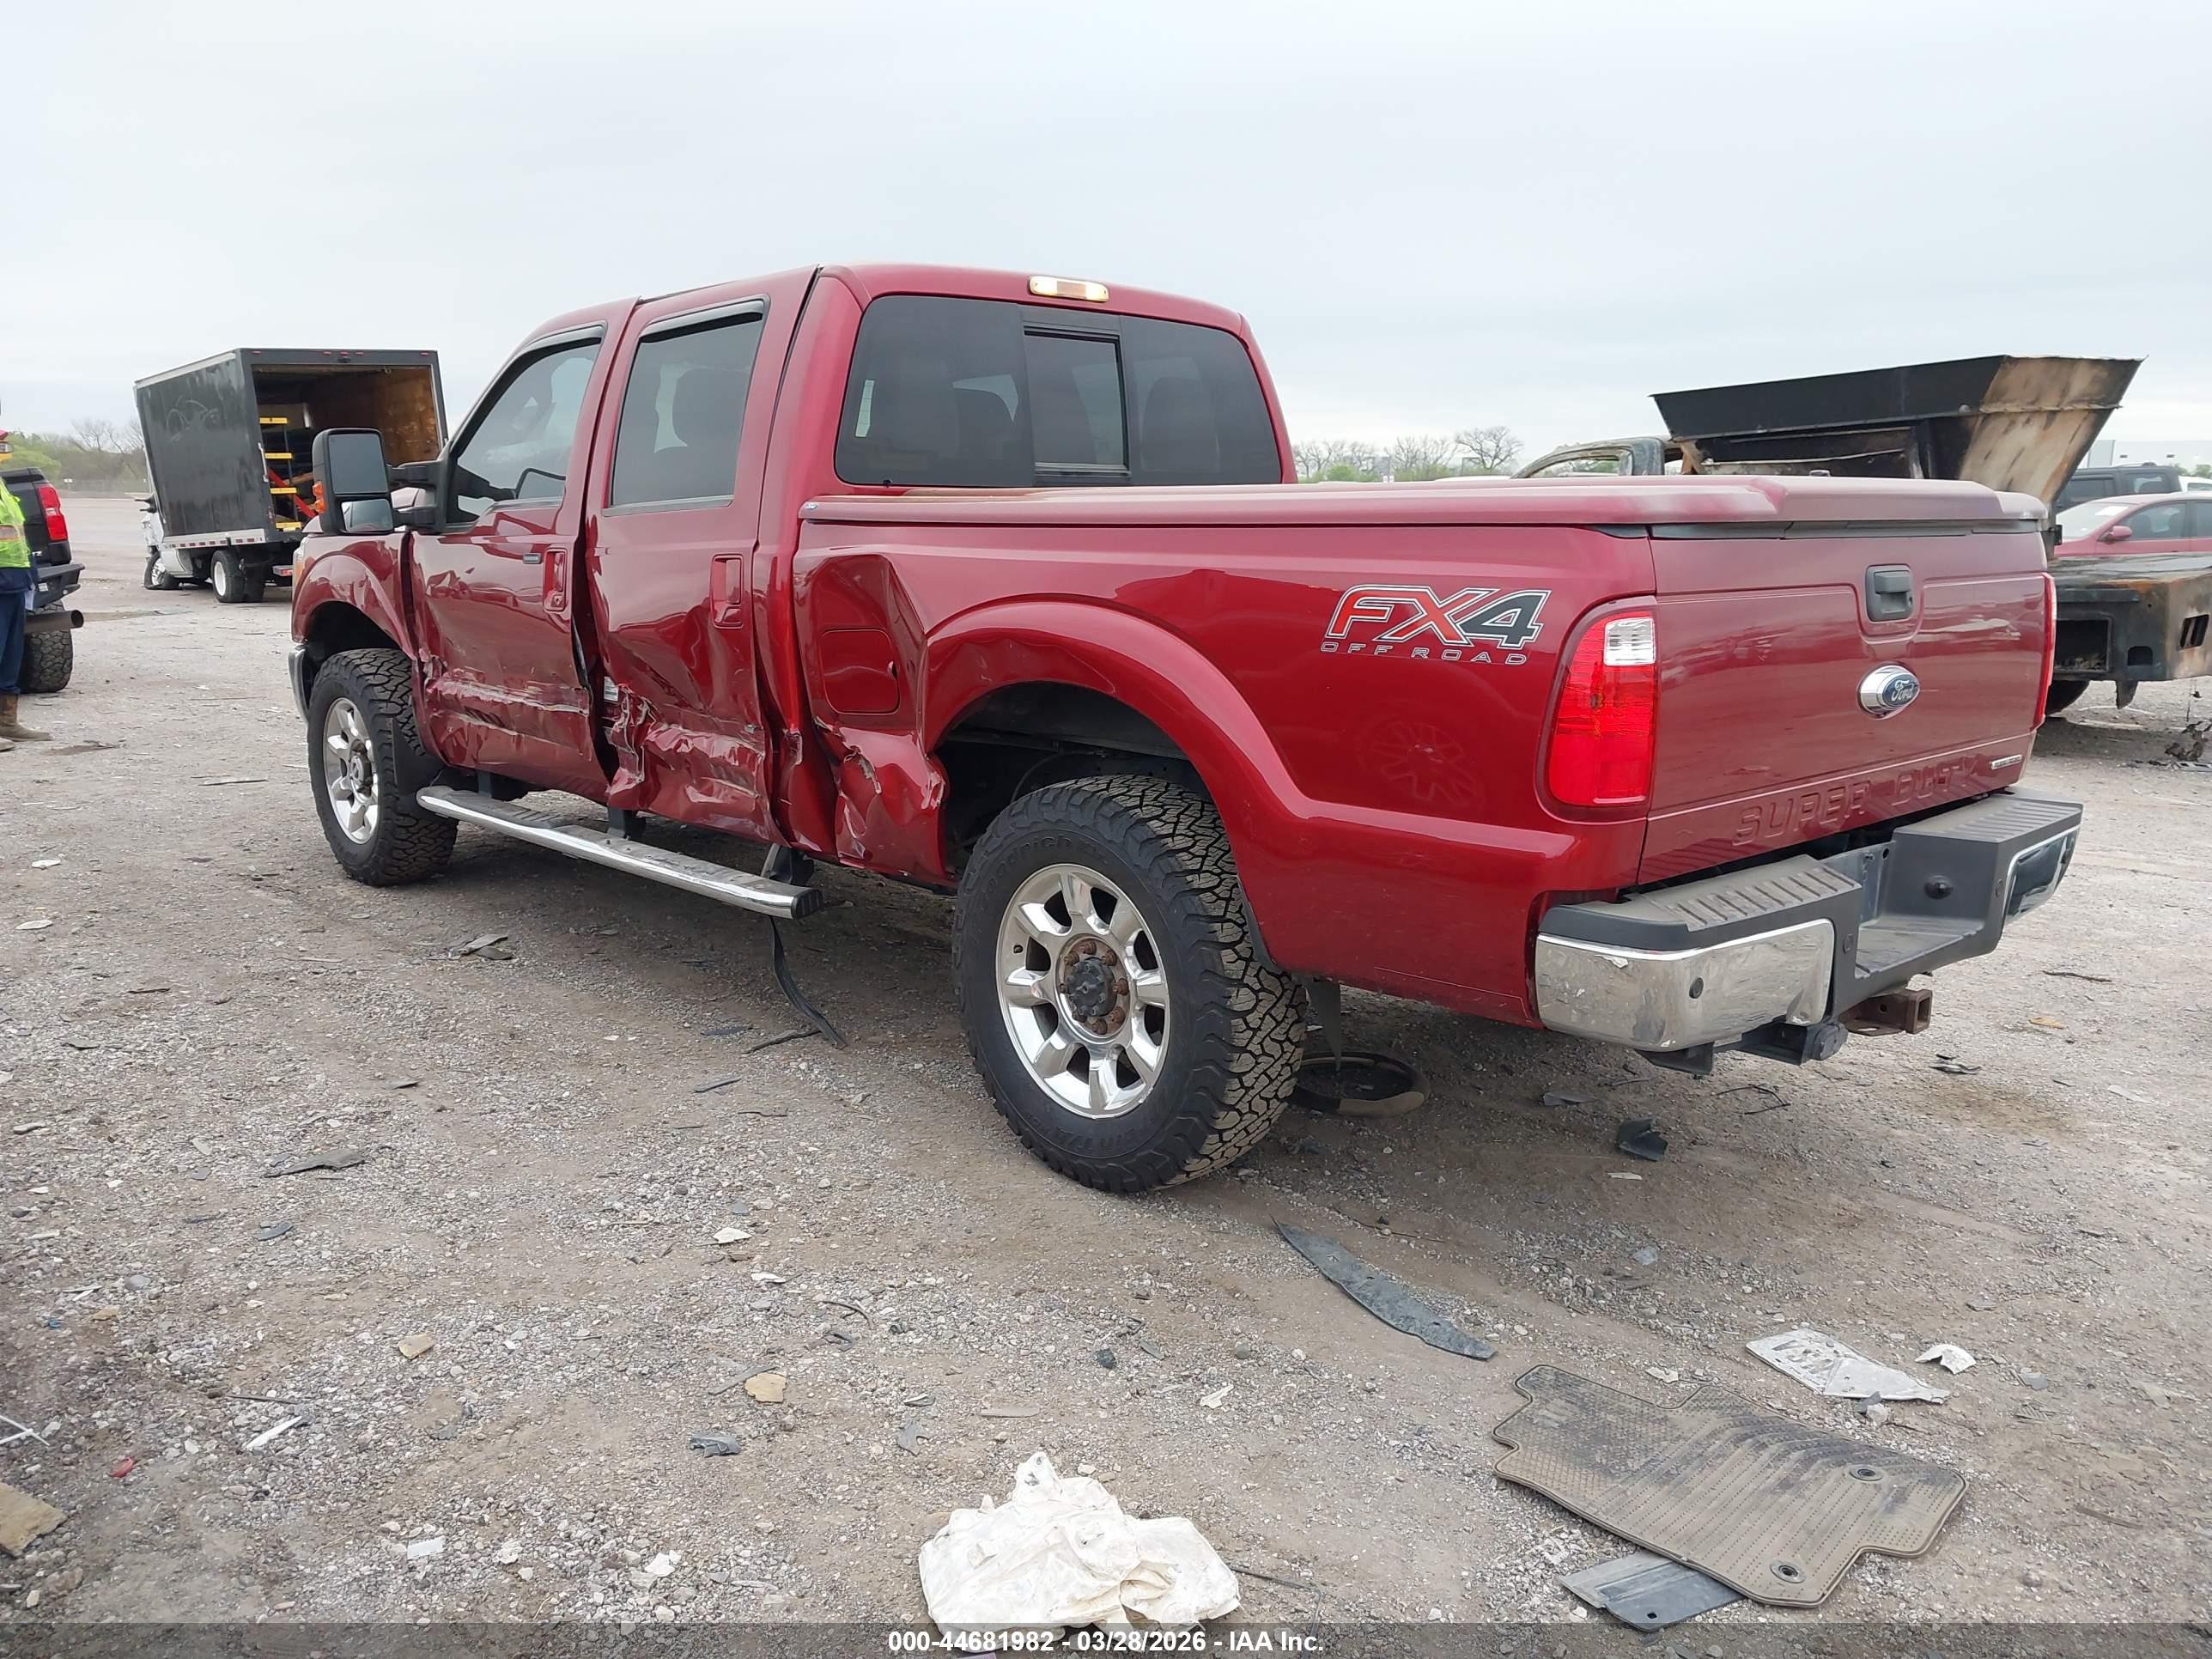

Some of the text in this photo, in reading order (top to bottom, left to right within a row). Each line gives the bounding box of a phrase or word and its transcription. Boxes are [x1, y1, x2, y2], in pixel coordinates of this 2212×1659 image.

[1325, 584, 1553, 650] FX4
[1320, 641, 1528, 665] OFF ROAD
[1891, 679, 1916, 702] Ford
[1732, 757, 1978, 847] SUPER DUTY
